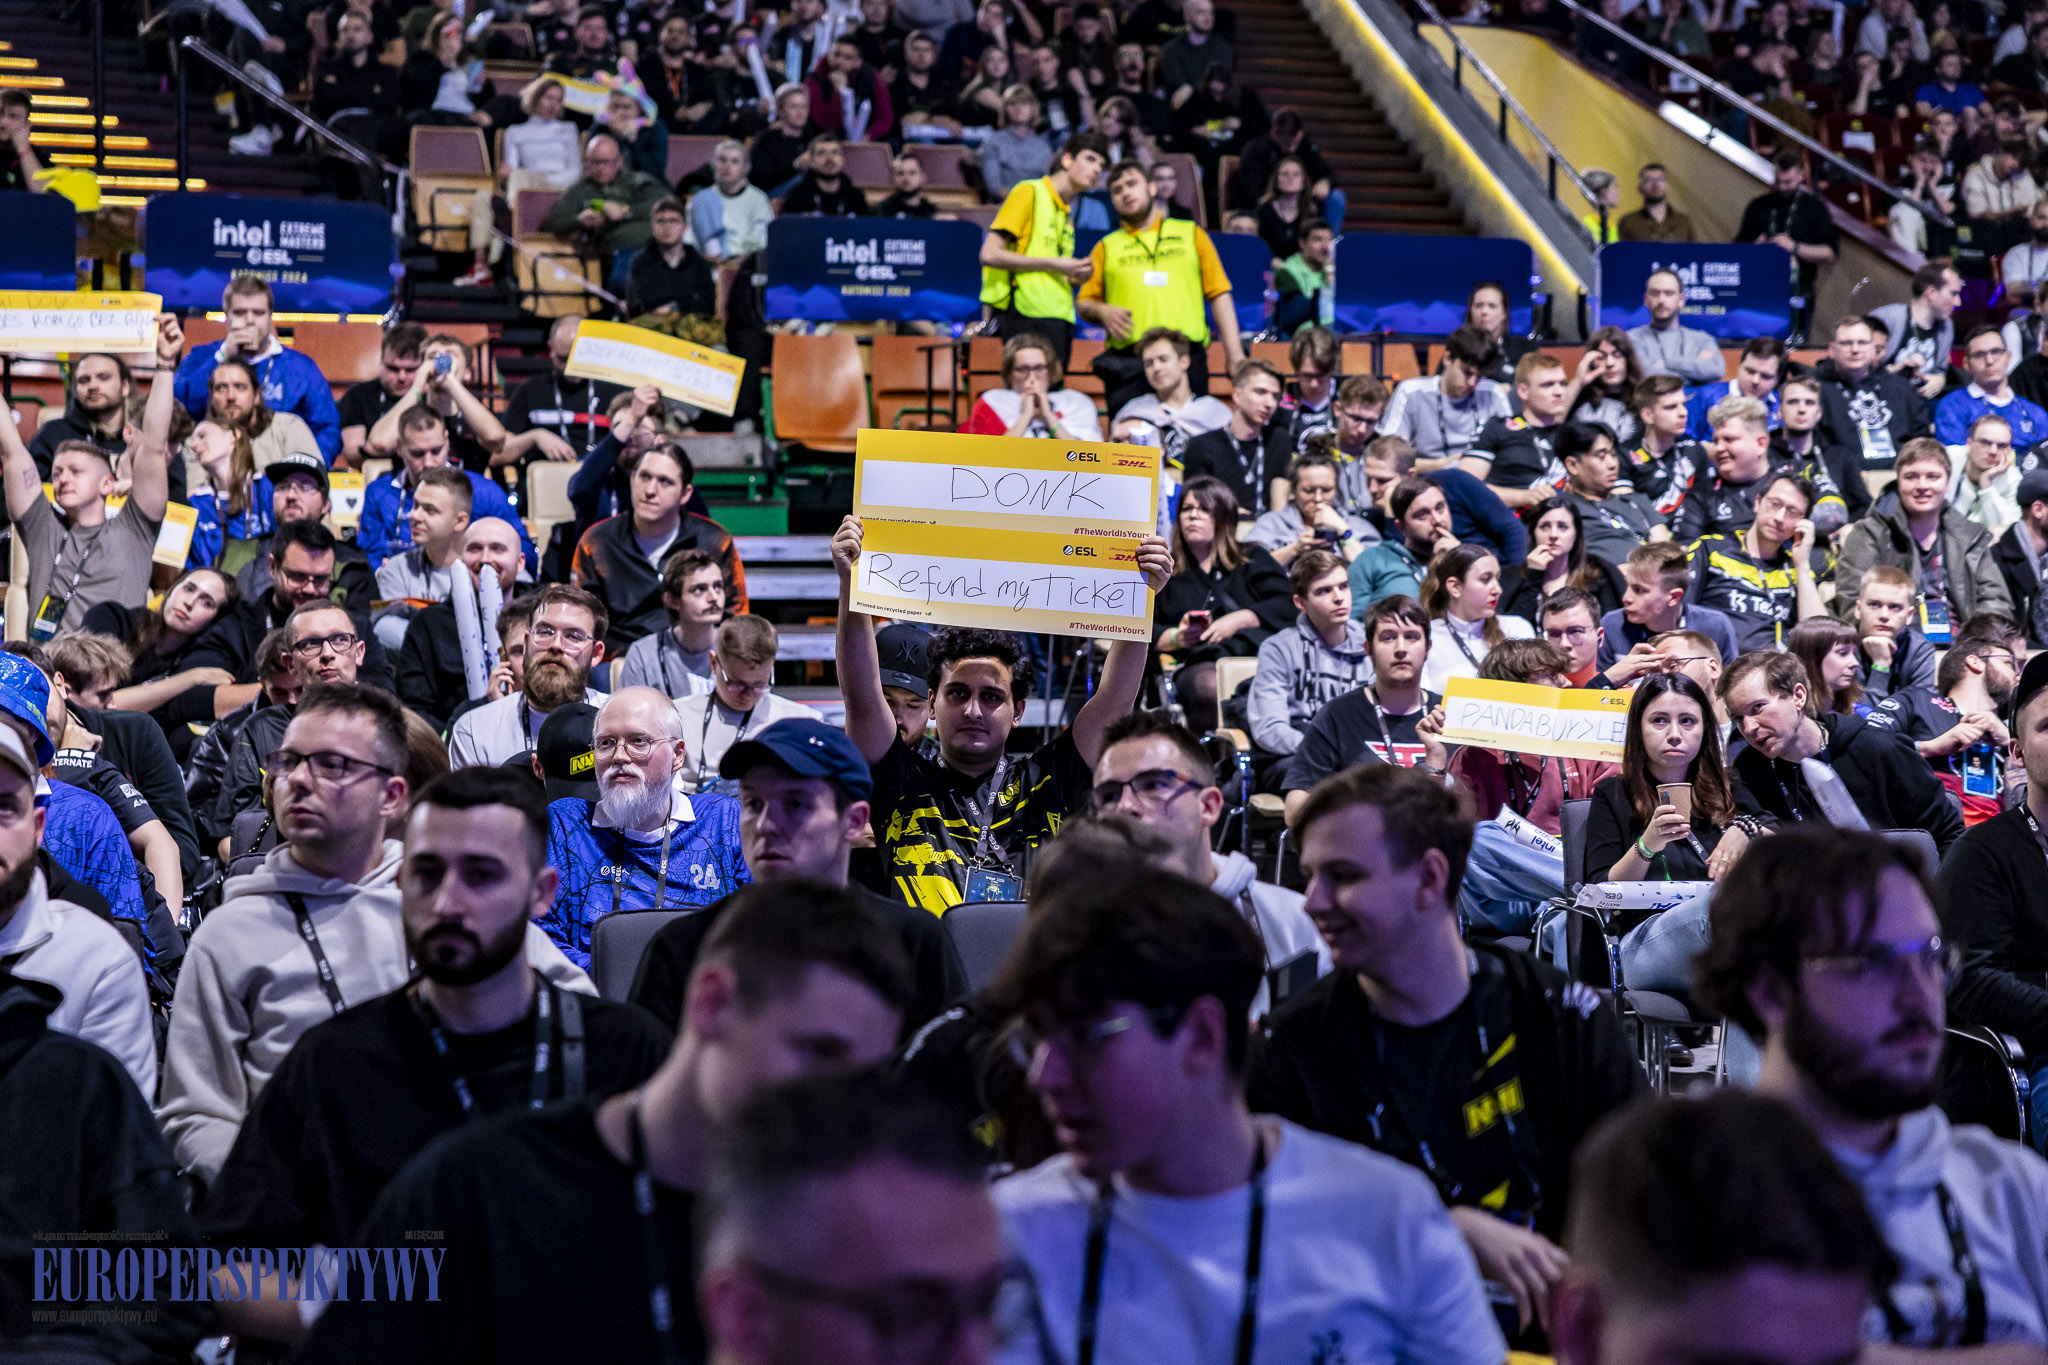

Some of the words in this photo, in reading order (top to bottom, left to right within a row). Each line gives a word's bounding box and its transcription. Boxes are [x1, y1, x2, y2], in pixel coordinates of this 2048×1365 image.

[213, 217, 272, 247] intel
[262, 248, 293, 266] ESL
[825, 237, 878, 263] intel
[869, 265, 897, 281] ESL
[1079, 452, 1100, 463] ESL
[1117, 460, 1147, 468] DHL
[951, 466, 1105, 510] DONK
[1075, 546, 1097, 557] ESL
[1114, 554, 1136, 562] DH
[867, 553, 987, 605] Refund
[997, 580, 1030, 612] my
[857, 601, 876, 609] Printed
[1069, 621, 1145, 635] #TheWorldIsYours
[52, 758, 93, 768] TERNATE
[1531, 836, 1556, 853] intel
[690, 863, 721, 890] 24
